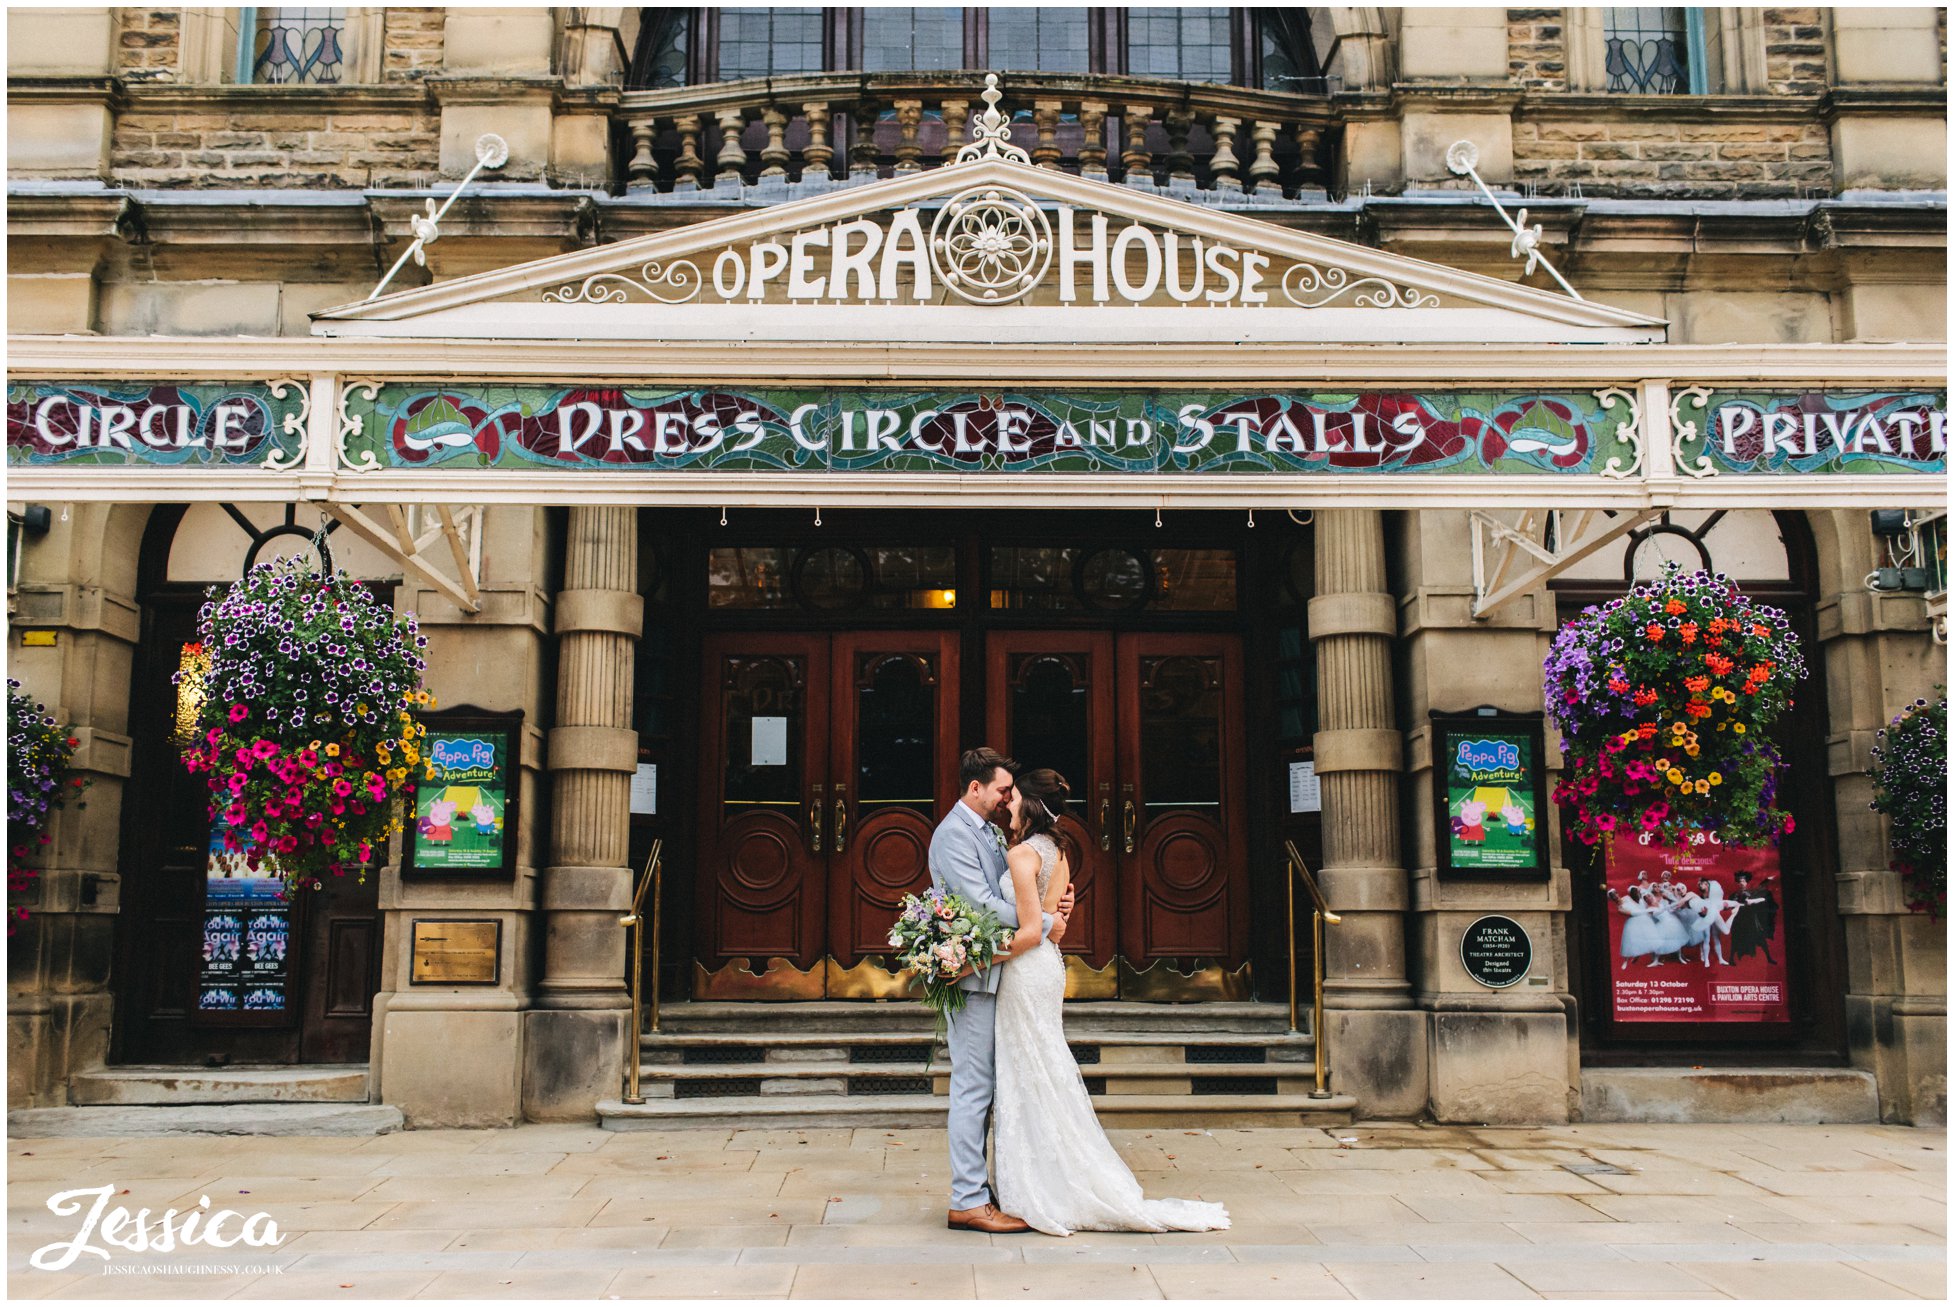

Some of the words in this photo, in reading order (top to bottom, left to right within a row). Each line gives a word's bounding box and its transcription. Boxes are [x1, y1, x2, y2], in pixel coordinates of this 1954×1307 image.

[713, 208, 932, 299] OPERA
[1058, 207, 1269, 302] HOUSE
[35, 395, 250, 449] CIRCLE
[558, 401, 766, 453] DRESS
[790, 404, 1035, 450] CIRCLE
[1055, 419, 1151, 446] AND
[1172, 404, 1426, 452] STALLS
[435, 743, 471, 766] Peppa
[472, 744, 491, 764] Pig
[1461, 744, 1496, 766] Peppa
[1498, 745, 1516, 765] Pig
[442, 769, 496, 781] Adventure!
[1471, 769, 1523, 781] Adventure!
[247, 930, 289, 944] Again
[254, 962, 264, 970] BEE
[265, 962, 279, 970] GEES
[1616, 980, 1647, 988] Saturday
